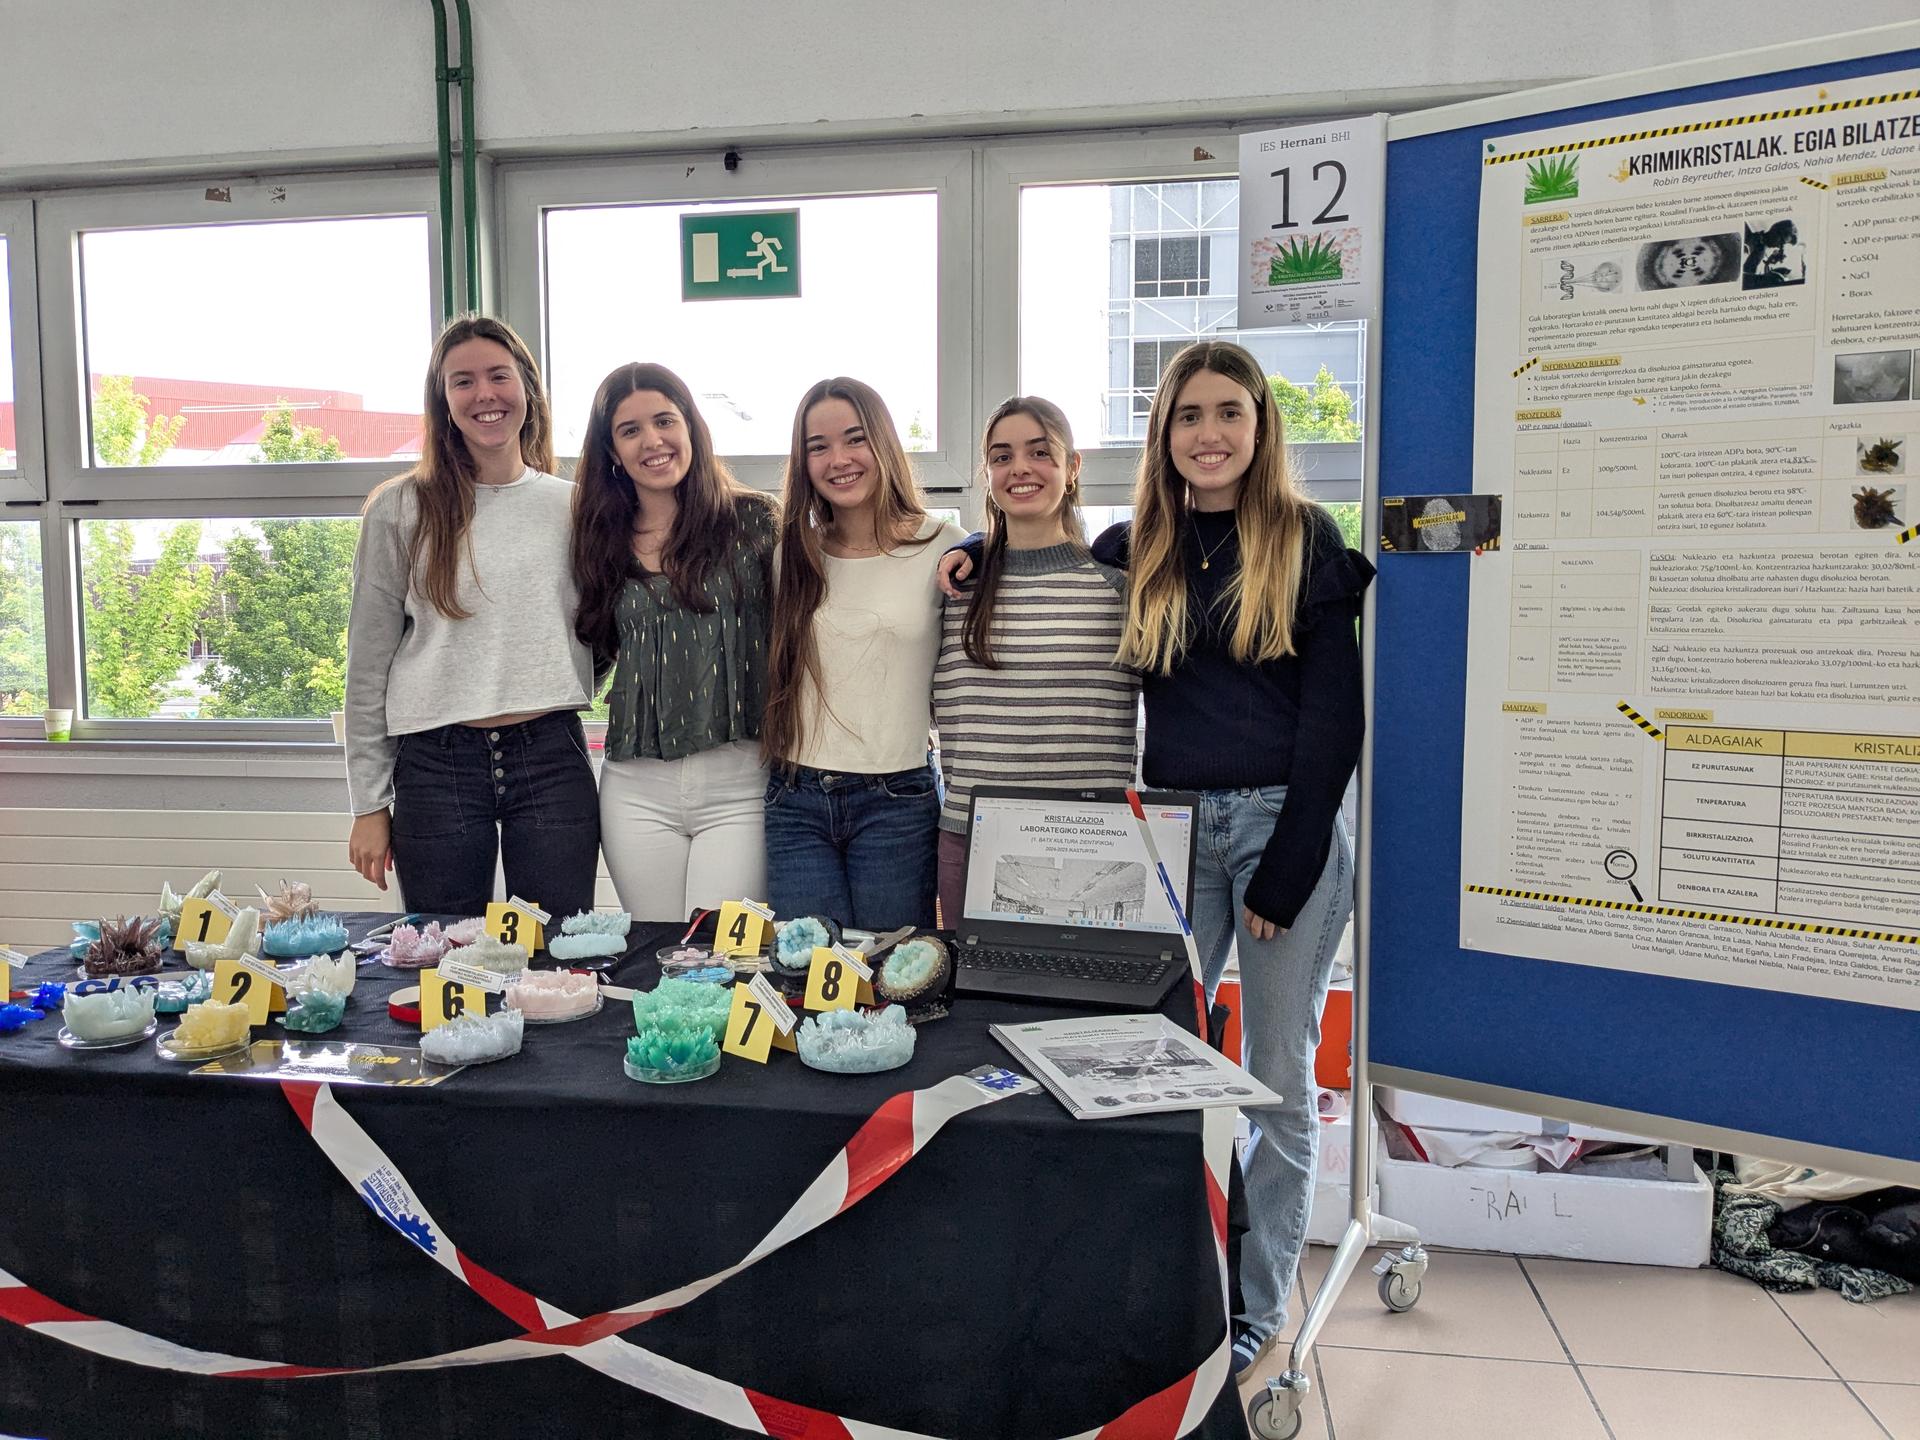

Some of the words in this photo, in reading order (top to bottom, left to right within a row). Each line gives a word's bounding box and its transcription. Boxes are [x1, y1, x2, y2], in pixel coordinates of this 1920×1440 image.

[1260, 142, 1276, 152] IES
[1280, 135, 1326, 150] Hernani
[1331, 131, 1350, 143] BHI
[1629, 136, 1787, 174] KRIMIKRISTALAK.
[1794, 128, 1836, 152] EGIA
[1842, 115, 1920, 145] BILATZE
[1652, 177, 1679, 186] Robin
[1681, 170, 1734, 183] Beyreuther,
[1737, 166, 1761, 175] Intza
[1764, 161, 1800, 172] Galdos,
[1803, 156, 1833, 166] Nahia
[1836, 150, 1877, 161] Mendez,
[1880, 145, 1915, 155] Udane
[1270, 160, 1349, 229] 12
[1849, 271, 1869, 279] NaCl
[1829, 422, 1861, 430] Argazkia
[1685, 734, 1762, 747] ALDAGAIAK
[1701, 764, 1753, 772] PURUTASUNAK
[1696, 798, 1746, 806] TENPERATURA
[1019, 825, 1078, 834] LABORATEGIKO
[1079, 828, 1128, 837] KOADERNOA
[1044, 815, 1105, 825] KRISTALIZAZIOA
[1686, 832, 1753, 842] BIRKRISTALIZAZIOA
[1711, 856, 1755, 864] KANTITATEA
[1677, 883, 1710, 891] DENBORA
[1726, 889, 1758, 897] AZALERA
[198, 910, 212, 942] 1
[500, 911, 519, 944] 3
[729, 913, 748, 946] 4
[229, 971, 252, 1005] 2
[822, 961, 843, 1001] 8
[442, 981, 464, 1020] 6
[739, 1001, 762, 1046] 7
[367, 1173, 401, 1215] INDUSTRIALES
